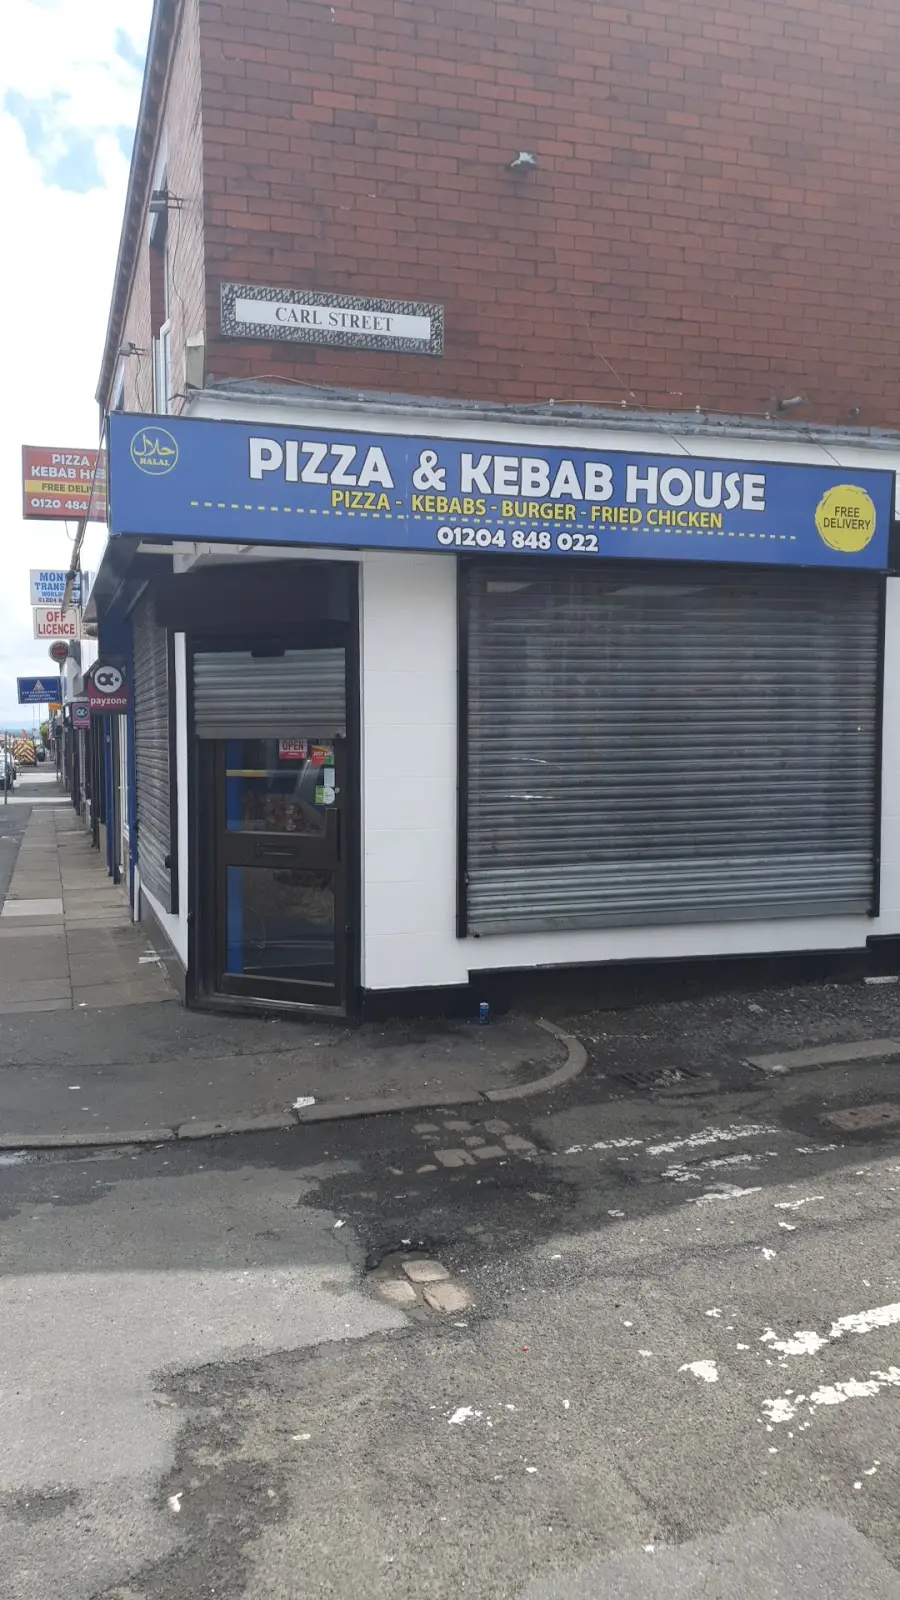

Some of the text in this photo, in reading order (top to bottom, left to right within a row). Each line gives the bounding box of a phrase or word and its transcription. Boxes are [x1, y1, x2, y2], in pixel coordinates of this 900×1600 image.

[275, 307, 394, 332] CARL STREET
[133, 433, 175, 456] حلال
[52, 453, 90, 467] PIZZA
[140, 457, 169, 466] HALAL
[31, 465, 76, 479] KEBAB
[249, 437, 766, 512] PIZZA & KEBAB HOUSE
[41, 482, 66, 492] FREE
[64, 501, 88, 511] 484
[331, 490, 391, 511] PIZZA
[411, 494, 486, 516] KEBABS
[502, 500, 577, 521] BURGER
[591, 505, 643, 525] FRIED
[646, 509, 723, 529] CHICKEN
[823, 506, 871, 530] FREE DELIVERY
[436, 525, 599, 552] 01204 848 022
[46, 611, 66, 622] OFF
[38, 624, 75, 635] LICENCE
[90, 697, 128, 707] payzone
[282, 741, 304, 751] OPEN
